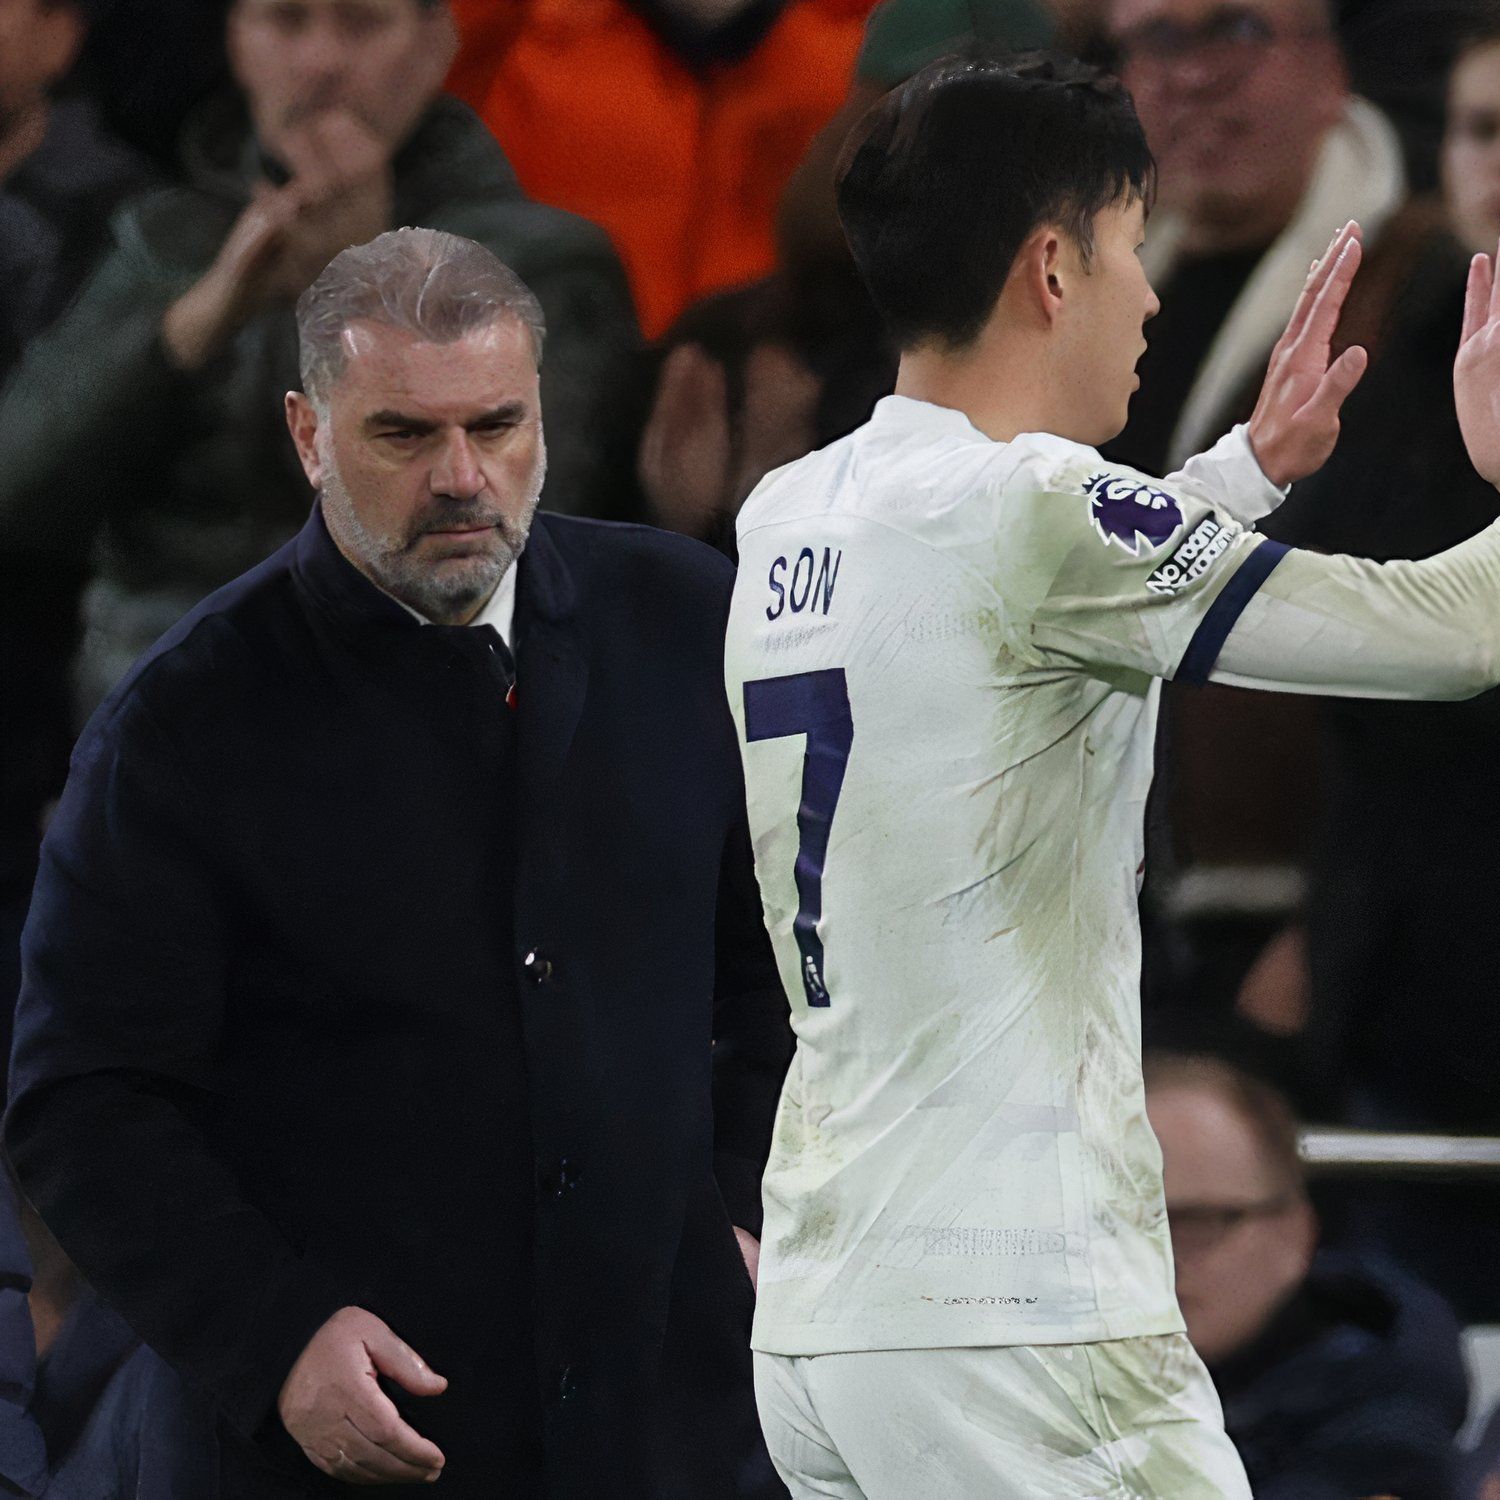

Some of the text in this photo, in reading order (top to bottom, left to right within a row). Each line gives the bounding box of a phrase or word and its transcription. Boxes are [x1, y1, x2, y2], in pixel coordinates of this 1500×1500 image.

[766, 547, 842, 621] SON
[1146, 564, 1180, 595] No
[1173, 519, 1219, 568] room
[743, 667, 854, 1007] 7
